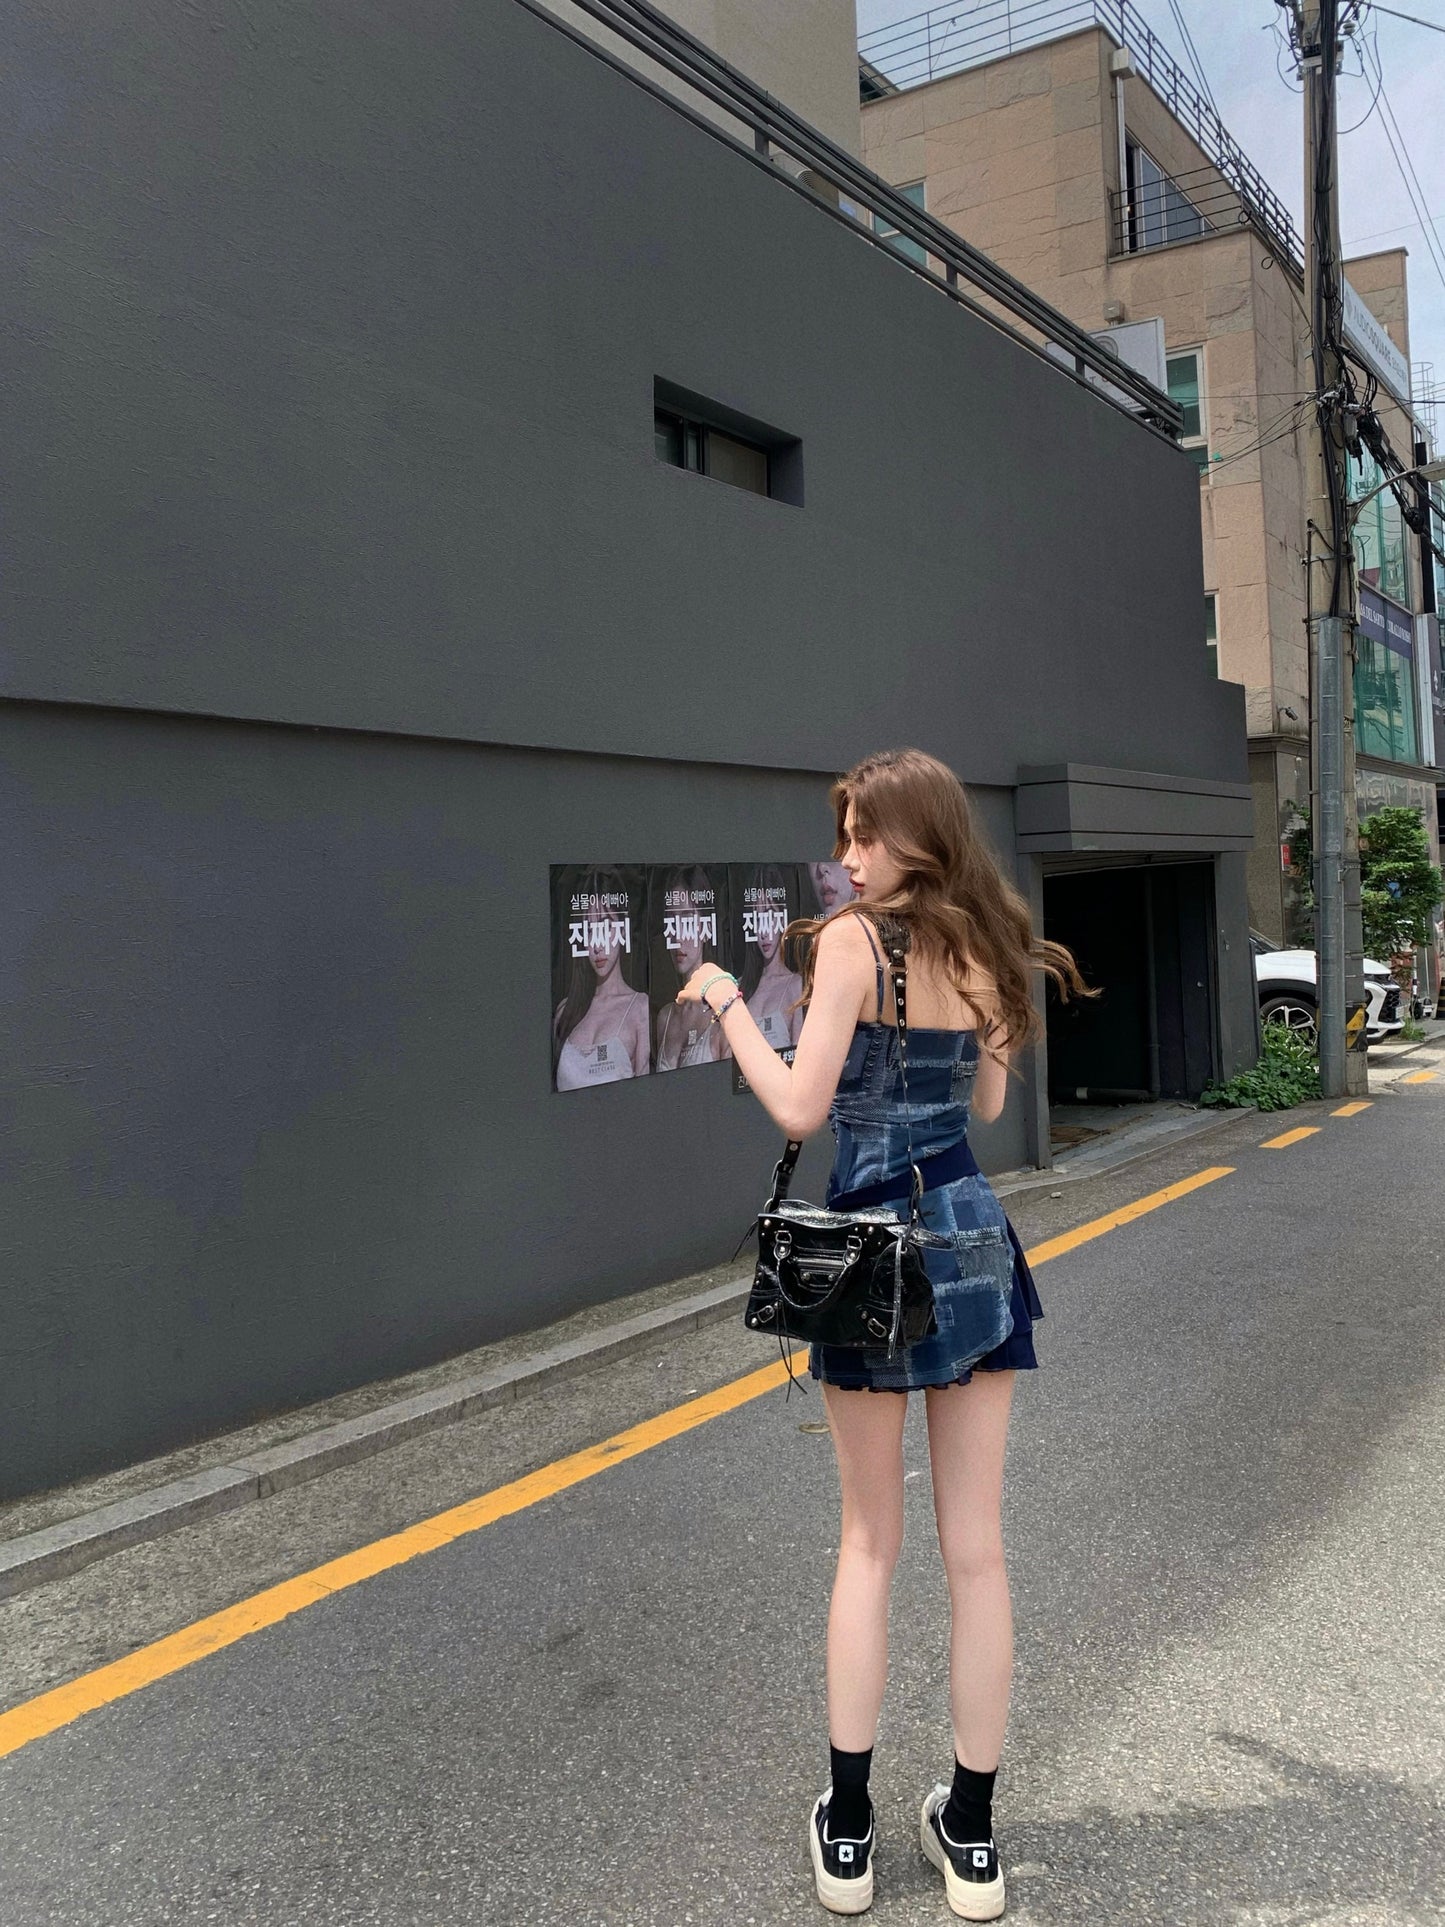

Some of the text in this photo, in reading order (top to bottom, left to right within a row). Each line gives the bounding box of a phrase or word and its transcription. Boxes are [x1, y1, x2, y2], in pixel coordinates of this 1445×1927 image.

[570, 892, 629, 910] 실물이 예뻐야
[664, 889, 715, 906] 실물이 예뻐야
[743, 886, 786, 902] 실물이 예뻐야
[568, 917, 631, 958] 진짜지
[663, 912, 717, 950] 진짜지
[742, 908, 788, 943] 진짜지
